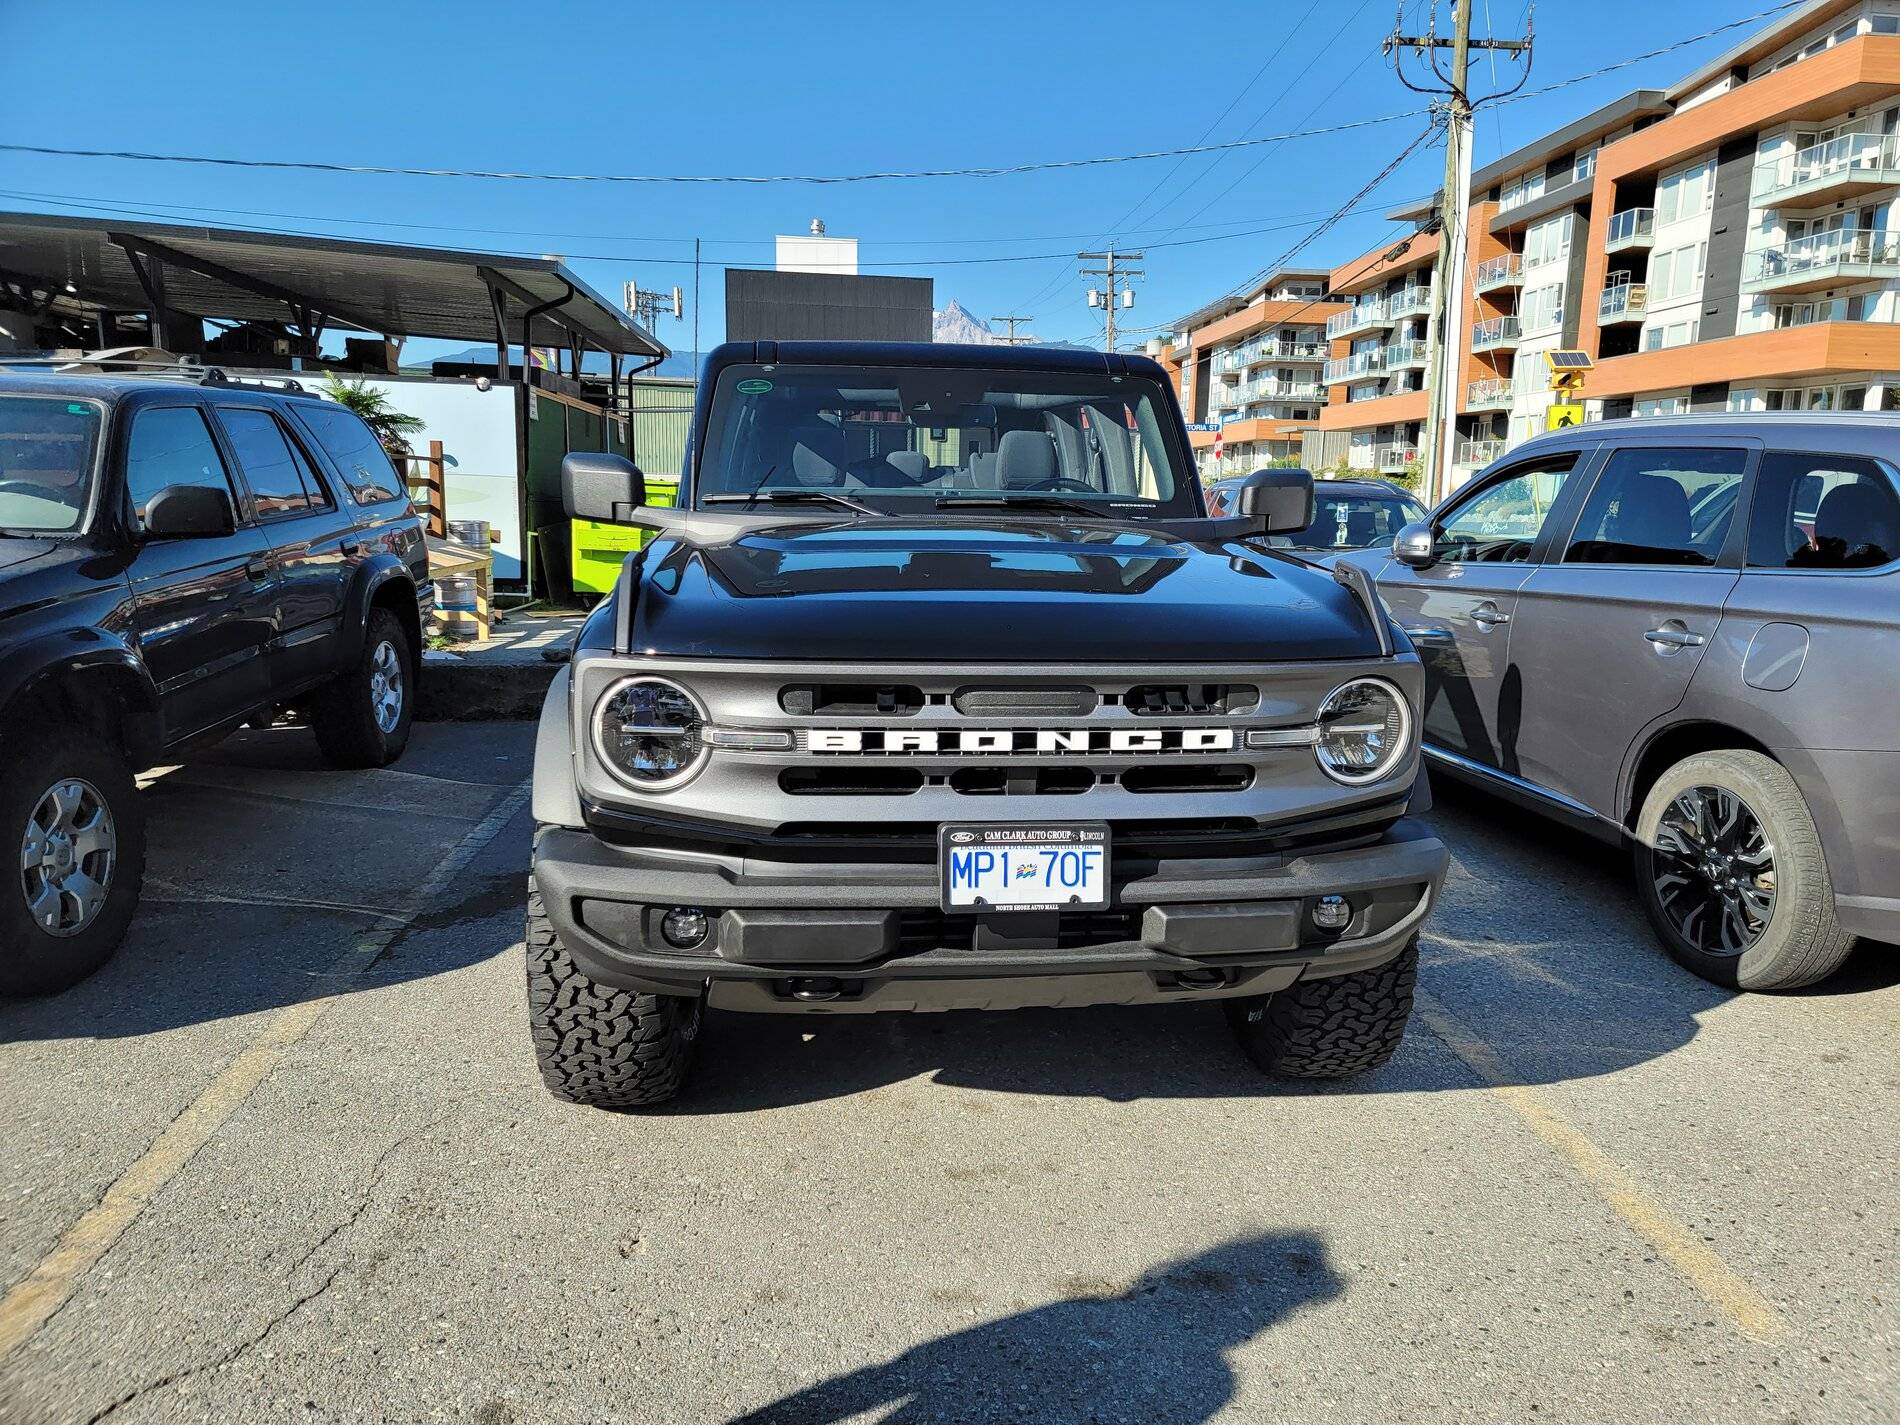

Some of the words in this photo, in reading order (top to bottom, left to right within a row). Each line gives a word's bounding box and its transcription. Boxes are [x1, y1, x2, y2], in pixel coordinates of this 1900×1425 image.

[807, 729, 1234, 751] BRONCO
[984, 831, 1001, 840] CAM
[1002, 831, 1026, 840] CLARK
[1027, 830, 1047, 840] AUTO
[1047, 830, 1072, 840] GROUP
[952, 851, 1009, 889] MP1
[1039, 851, 1102, 888] 70F
